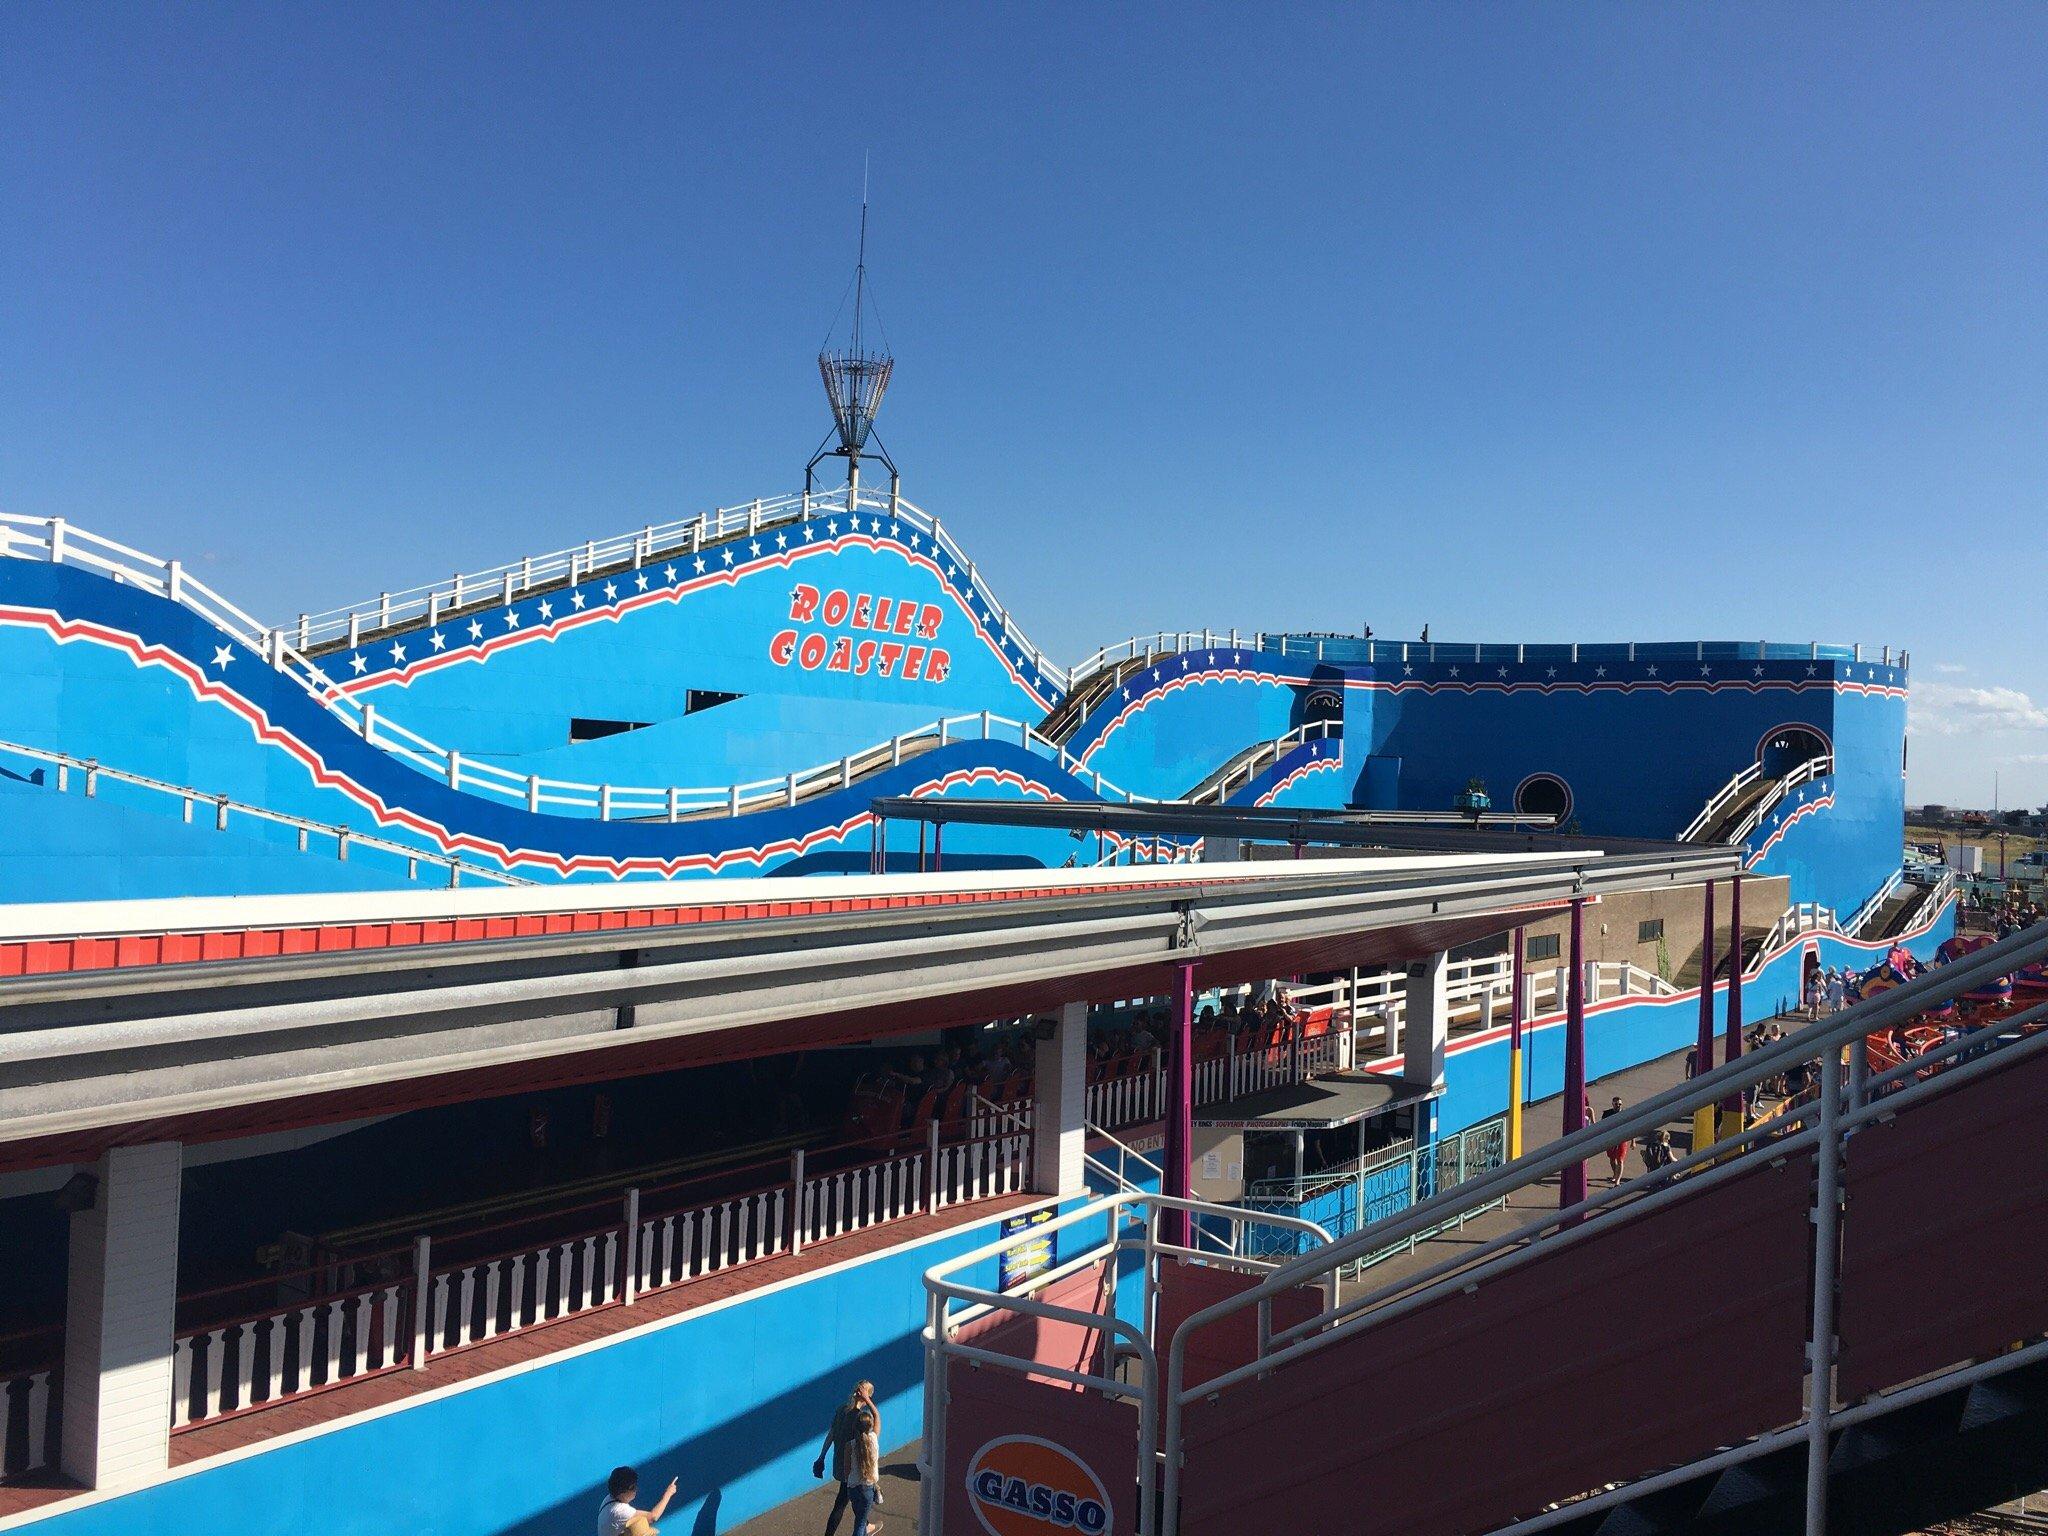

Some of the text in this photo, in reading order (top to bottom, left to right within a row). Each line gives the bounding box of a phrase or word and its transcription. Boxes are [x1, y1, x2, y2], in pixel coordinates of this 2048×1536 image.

[790, 584, 943, 640] ROLLER
[770, 630, 950, 682] COASTER
[1131, 1138, 1144, 1152] NO
[975, 1470, 1106, 1534] GASSO
